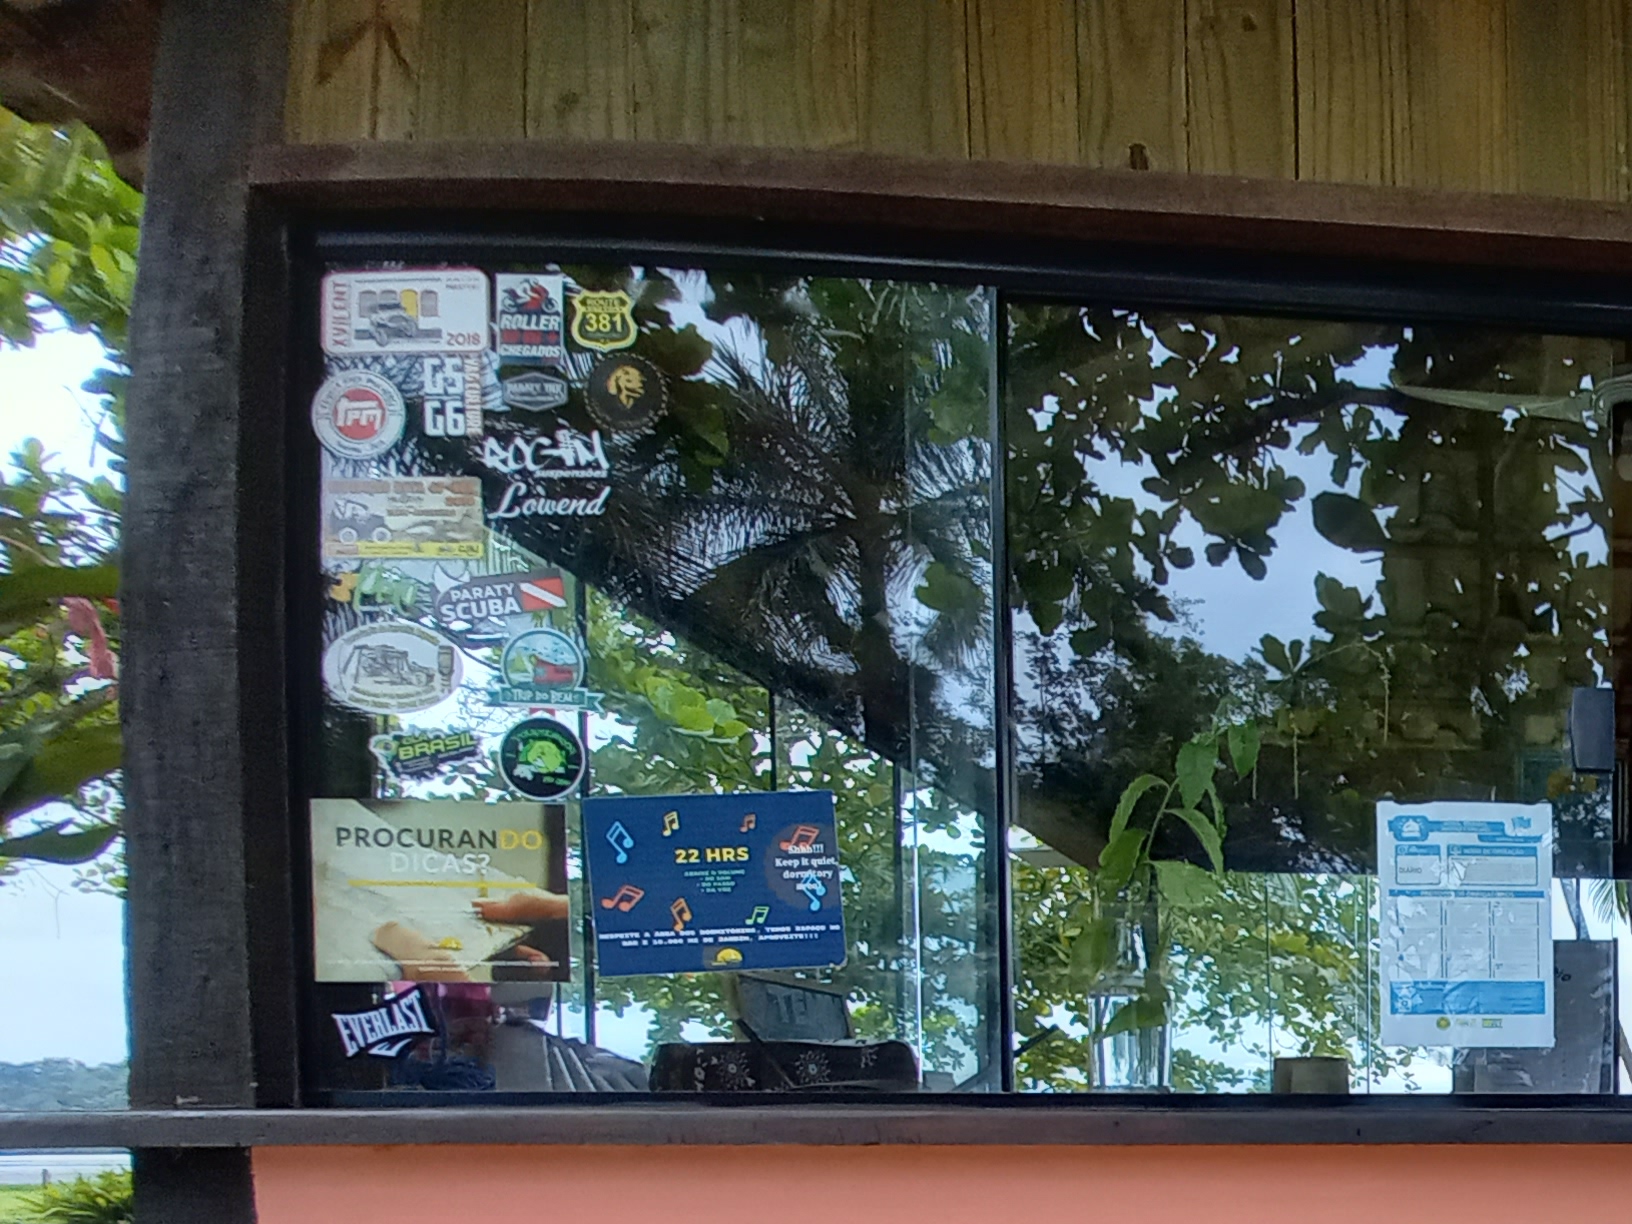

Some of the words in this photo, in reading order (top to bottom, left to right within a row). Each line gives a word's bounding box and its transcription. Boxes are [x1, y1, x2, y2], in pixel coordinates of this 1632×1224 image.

[501, 314, 560, 331] ROLLER
[585, 313, 622, 333] 381
[447, 333, 480, 346] 2018
[424, 401, 466, 436] G6
[487, 482, 611, 519] Lowend
[449, 583, 515, 602] PARATY
[440, 597, 521, 621] SCUBA
[397, 733, 477, 760] BRASIL
[335, 826, 543, 850] PROCURANDO
[390, 852, 491, 875] DICAS?
[675, 849, 700, 863] 22
[706, 847, 749, 862] HRS
[775, 857, 800, 868] Keep
[801, 857, 809, 866] it
[332, 989, 435, 1057] EVERLAST
